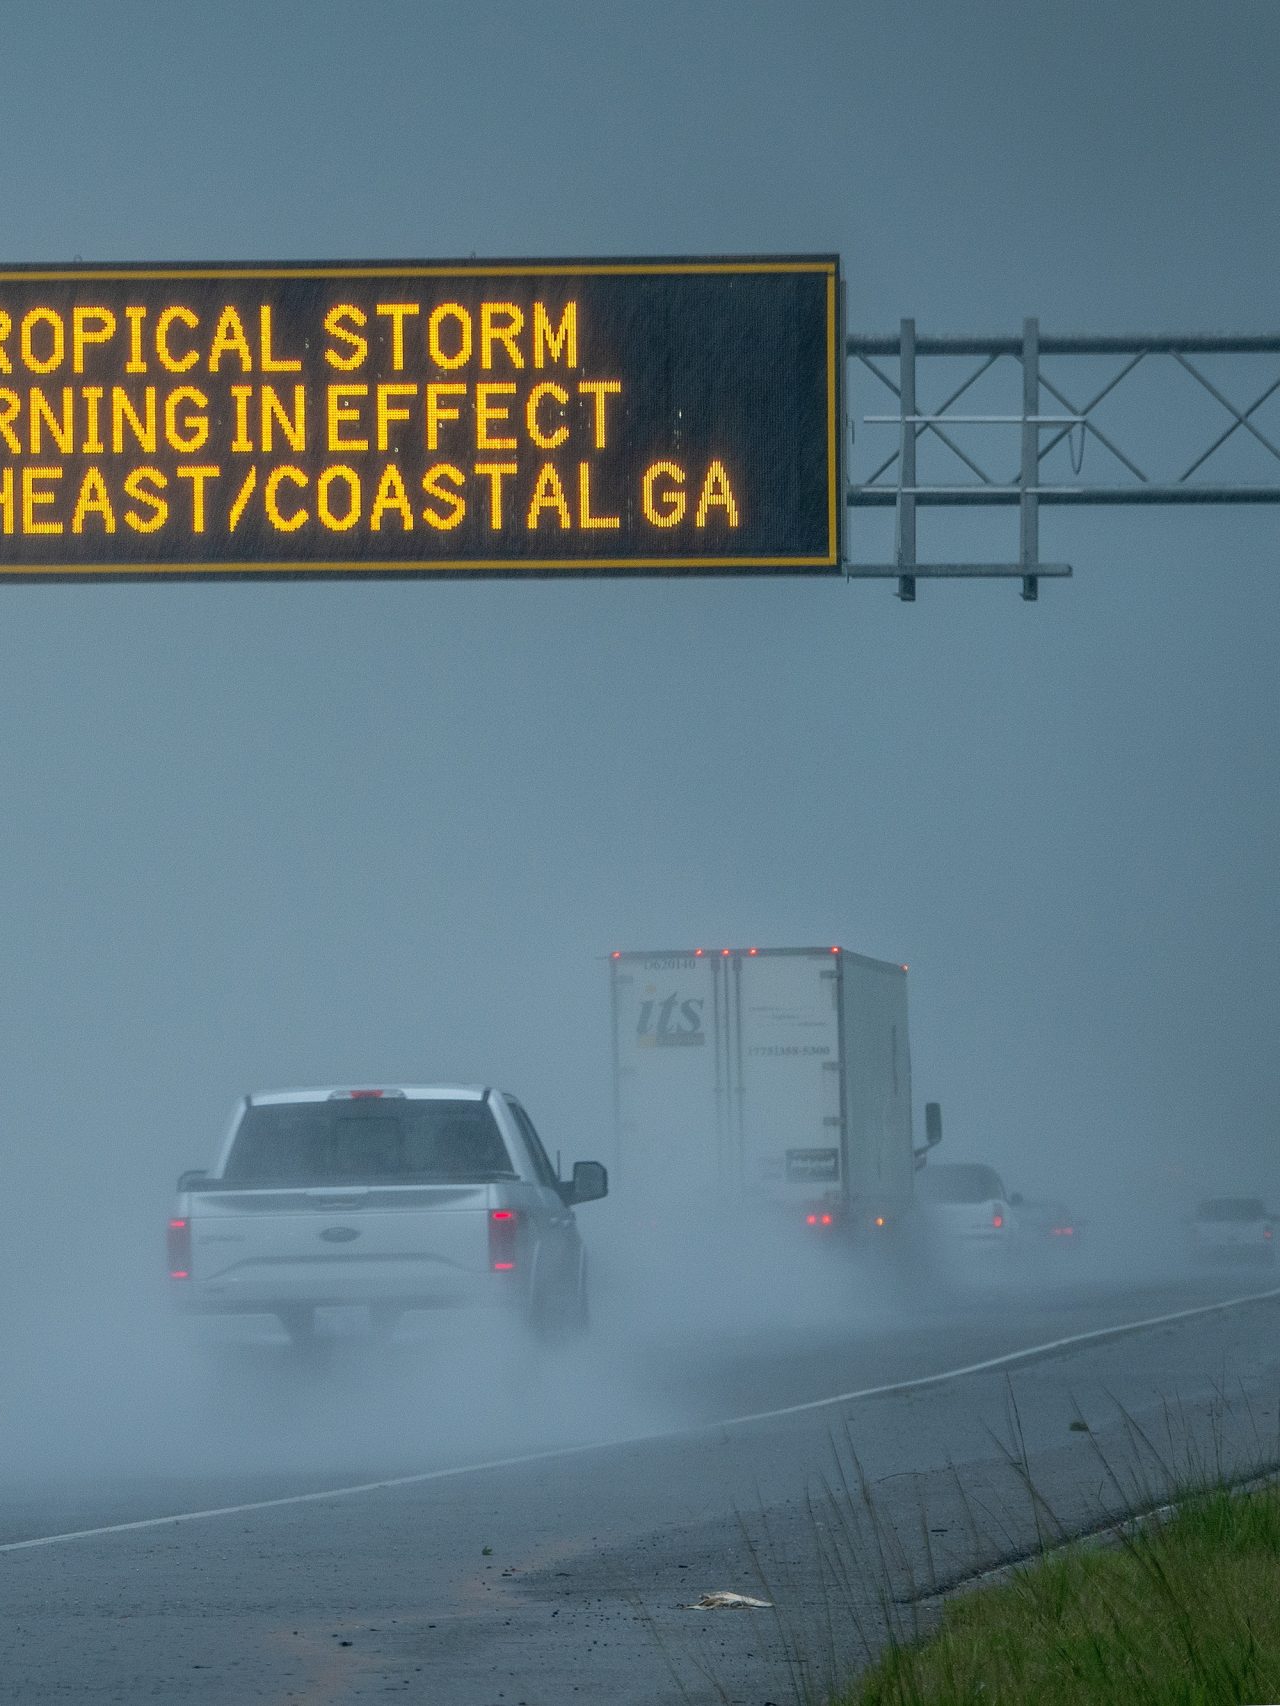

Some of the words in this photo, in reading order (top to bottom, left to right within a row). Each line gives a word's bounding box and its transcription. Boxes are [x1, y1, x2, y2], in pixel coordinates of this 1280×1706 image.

[323, 301, 577, 371] STORM
[230, 383, 306, 452] IN
[327, 380, 622, 451] EFFECT
[642, 460, 739, 528] GA
